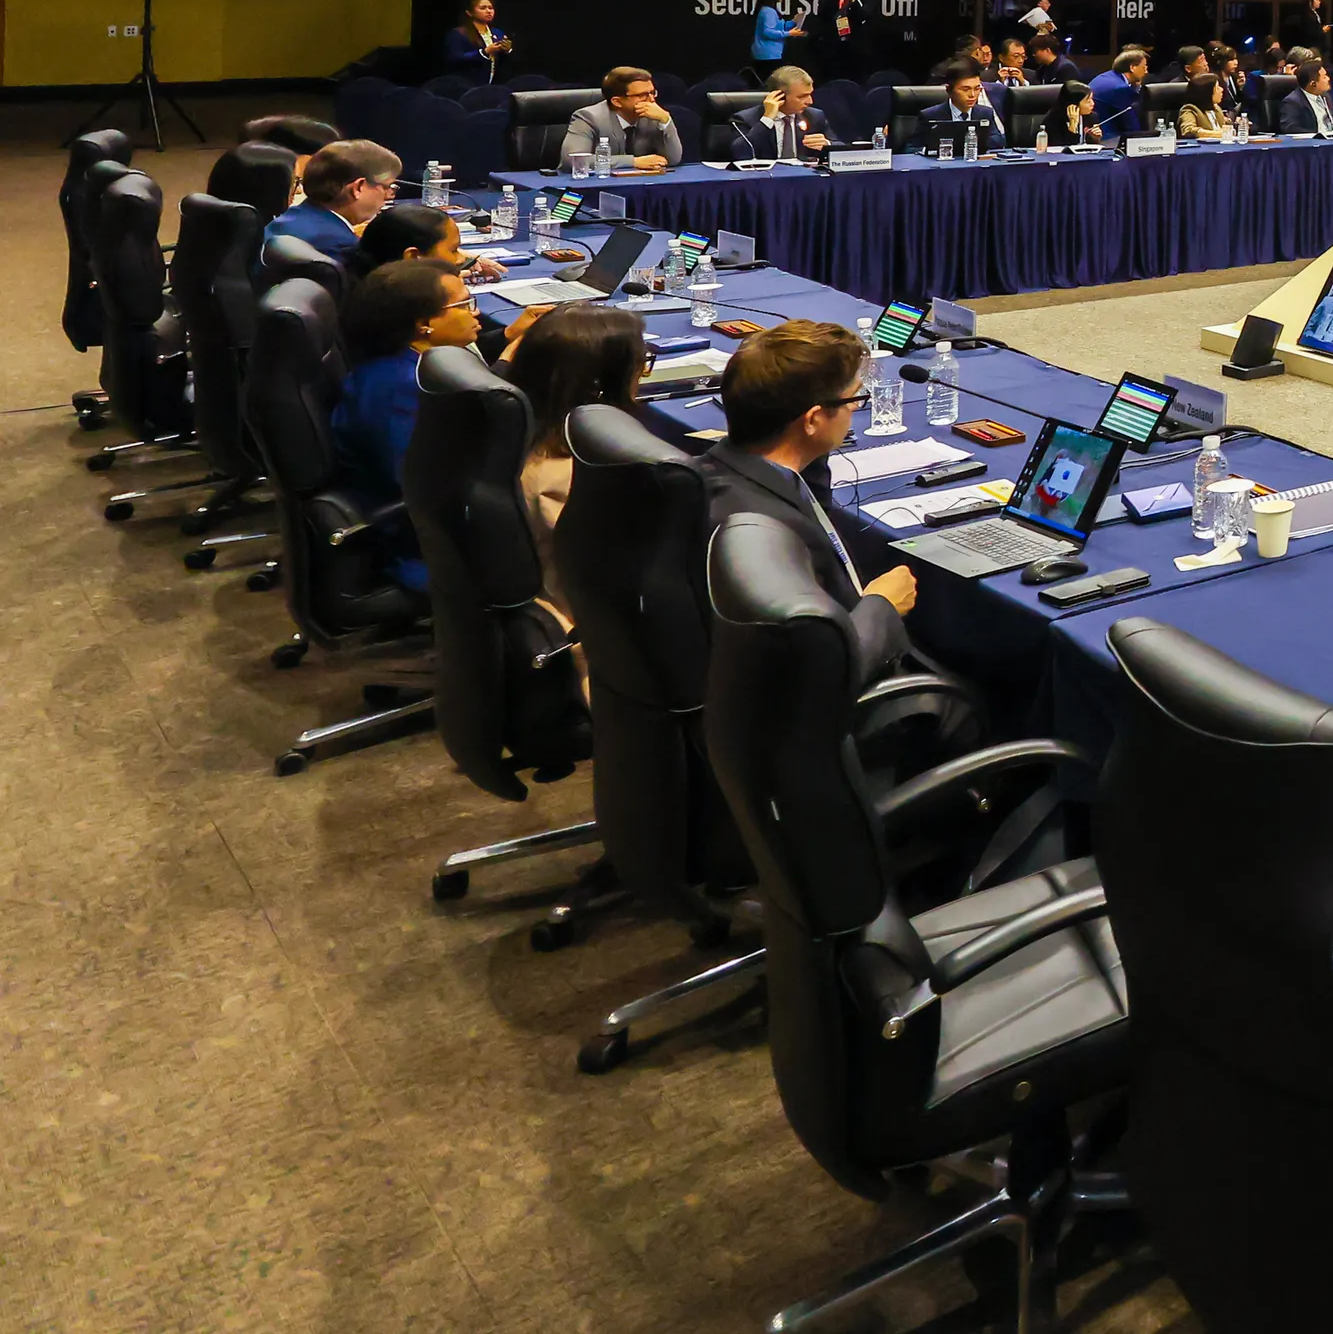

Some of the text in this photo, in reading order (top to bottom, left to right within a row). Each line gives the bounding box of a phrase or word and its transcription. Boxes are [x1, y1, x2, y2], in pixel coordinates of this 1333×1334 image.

[1138, 144, 1164, 153] Singapore
[1172, 400, 1214, 424] New Zealand
